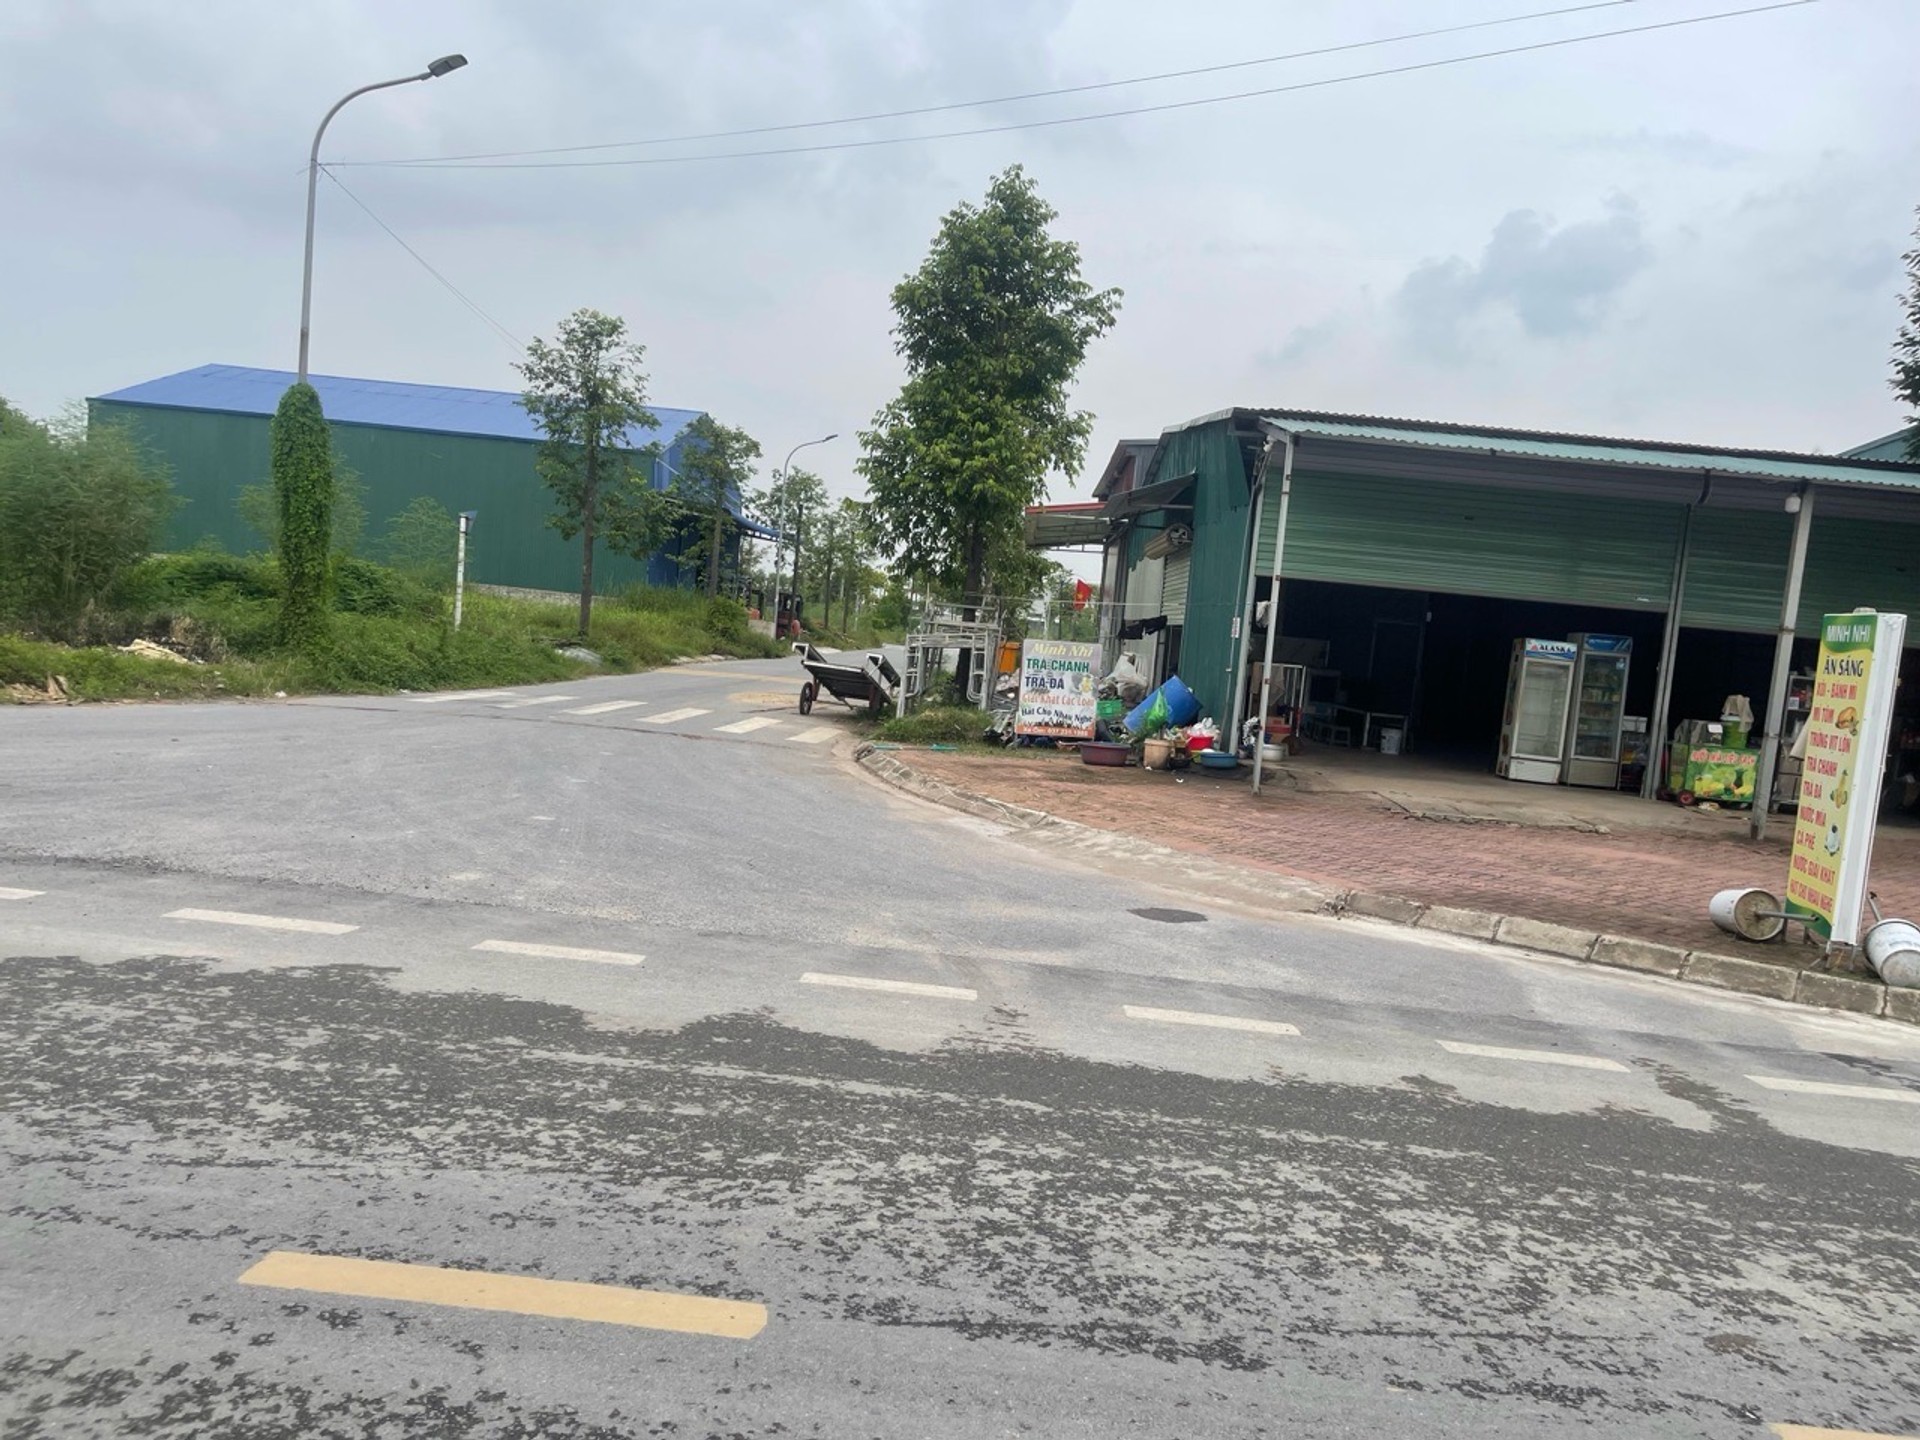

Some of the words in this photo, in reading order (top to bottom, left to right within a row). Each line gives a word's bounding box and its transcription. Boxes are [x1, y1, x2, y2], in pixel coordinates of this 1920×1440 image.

[1826, 625, 1851, 642] MINH
[1852, 624, 1871, 643] NHI
[1031, 643, 1066, 655] Minh
[1068, 645, 1093, 657] Nhi
[1051, 660, 1090, 673] CHANH
[1823, 655, 1836, 675] ĂN
[1838, 655, 1864, 677] SÁNG
